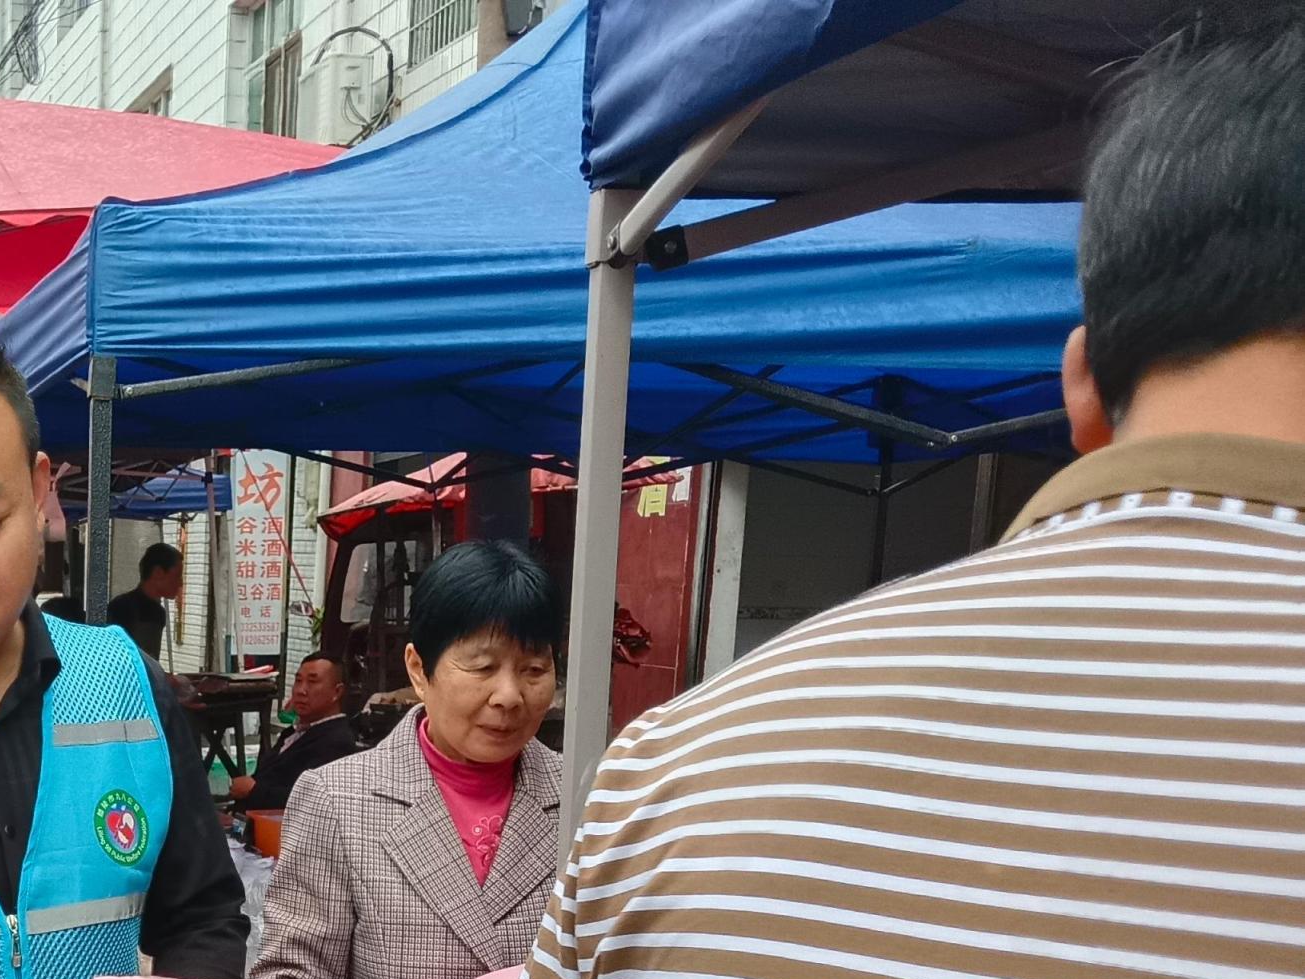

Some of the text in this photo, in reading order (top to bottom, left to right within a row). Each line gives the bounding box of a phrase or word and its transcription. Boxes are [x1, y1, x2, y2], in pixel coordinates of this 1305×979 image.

[237, 463, 283, 511] 坊
[236, 516, 283, 534] 谷酒
[235, 538, 282, 556] 米酒
[236, 560, 282, 578] 甜酒
[240, 605, 272, 618] 电话
